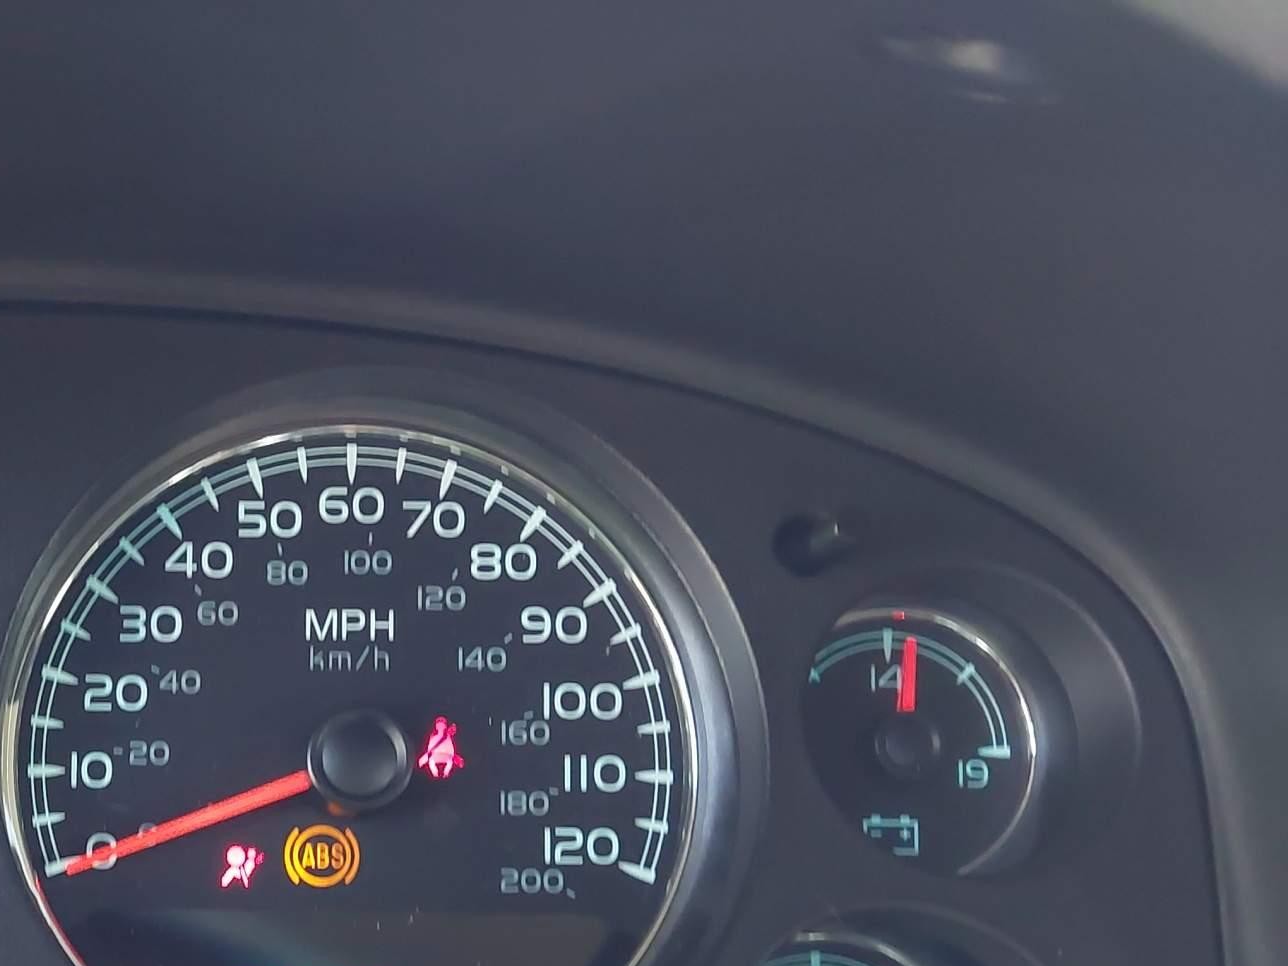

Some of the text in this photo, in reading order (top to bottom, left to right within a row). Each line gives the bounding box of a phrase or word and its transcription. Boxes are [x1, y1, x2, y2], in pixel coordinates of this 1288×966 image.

[237, 501, 303, 538] 50
[318, 487, 385, 525] 60
[401, 501, 466, 538] 70
[164, 542, 234, 579] 40
[266, 561, 308, 586] 80
[343, 550, 392, 575] 100
[468, 543, 538, 581] 80
[417, 586, 467, 611] 120
[119, 606, 183, 643] 30
[197, 601, 239, 627] 60
[304, 609, 396, 642] MPH
[520, 606, 588, 644] 90
[309, 645, 391, 672] km/h
[457, 646, 507, 672] 140
[83, 673, 147, 712] 20
[160, 670, 201, 695] 40
[870, 663, 902, 693] 14
[541, 682, 622, 721] 100
[500, 721, 550, 745] 160
[129, 741, 170, 766] 20
[69, 751, 113, 789] 10
[562, 755, 625, 793] 110
[957, 759, 989, 789] 19
[499, 791, 549, 816] 180
[301, 842, 343, 871] ABS
[543, 826, 619, 865] 120
[500, 868, 563, 894] 200
